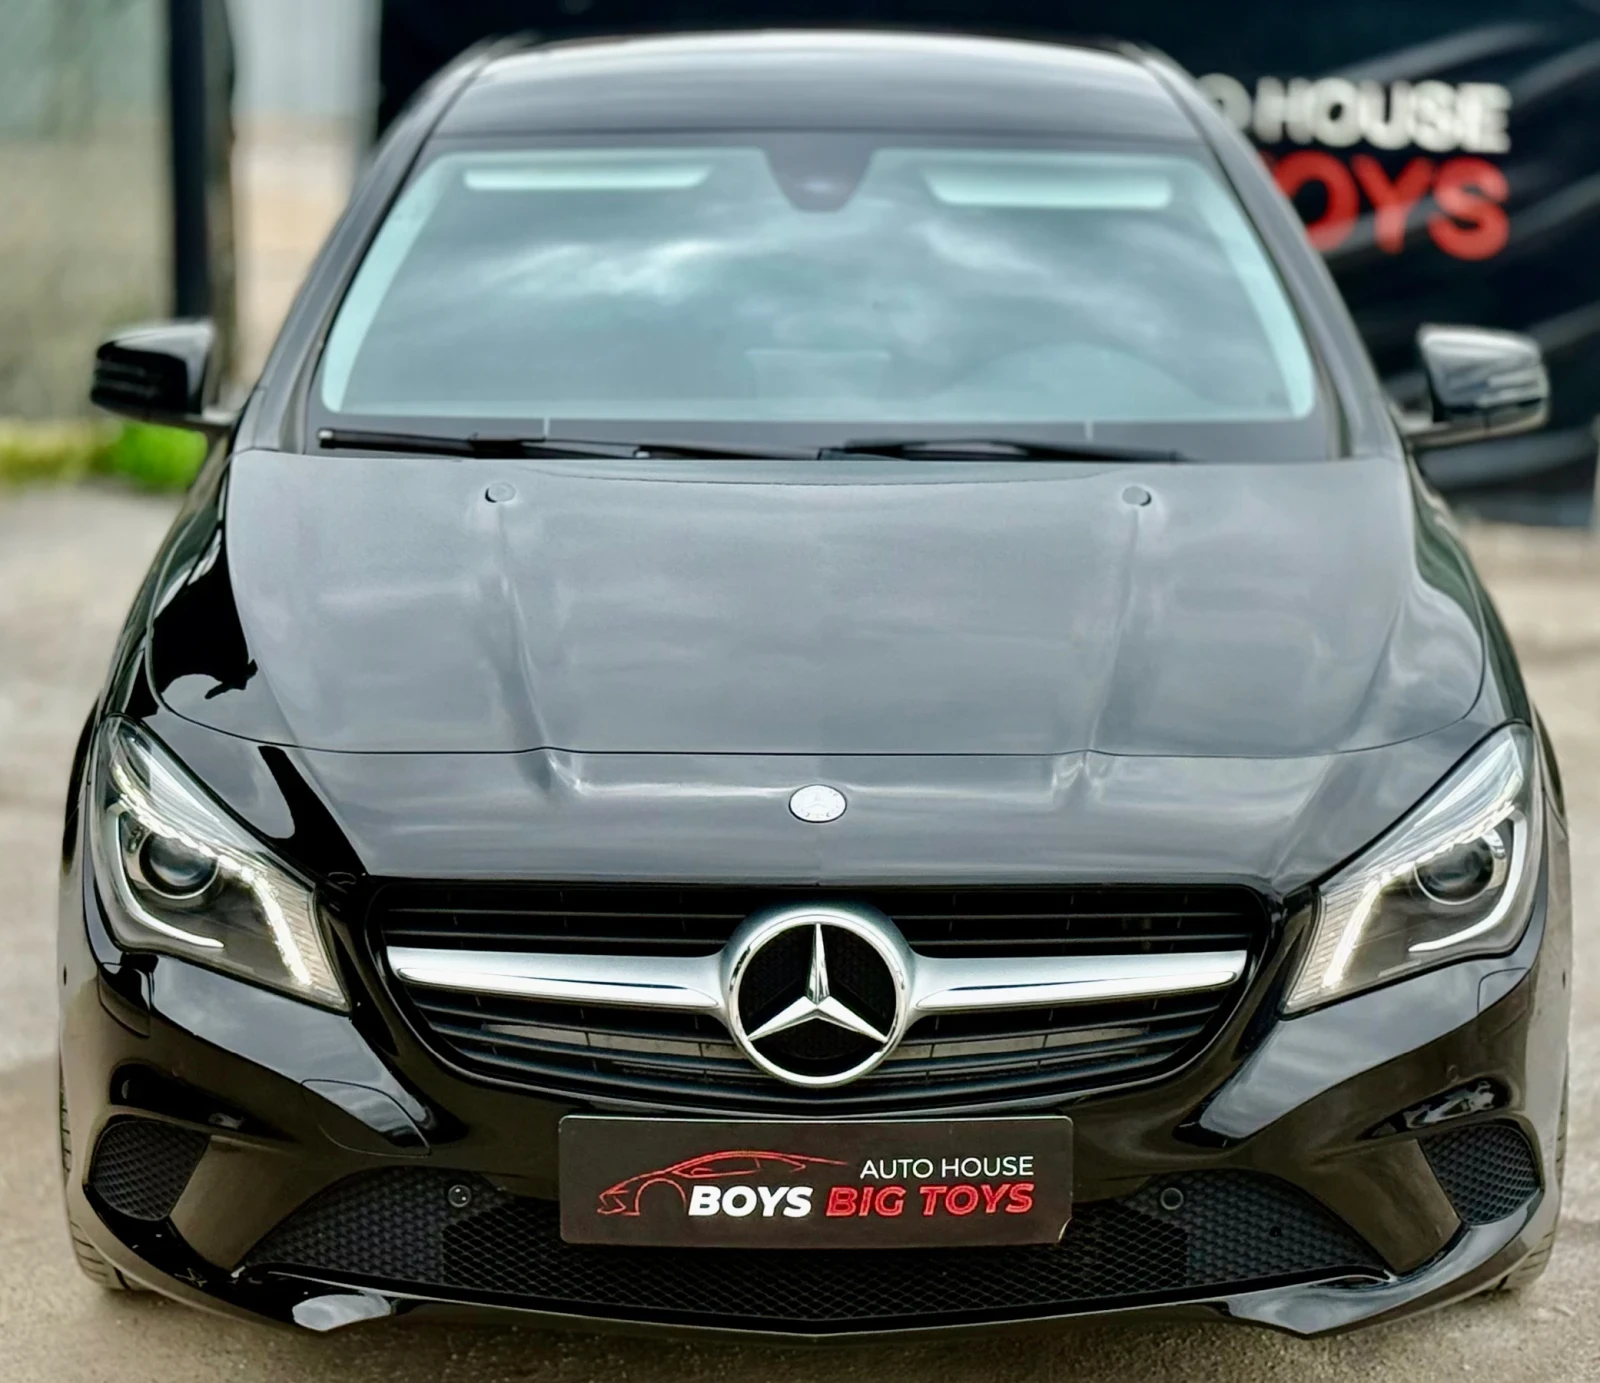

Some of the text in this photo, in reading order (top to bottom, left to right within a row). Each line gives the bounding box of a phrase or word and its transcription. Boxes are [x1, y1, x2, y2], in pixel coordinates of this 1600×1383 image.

[1253, 76, 1511, 154] HOUSE
[1264, 150, 1510, 260] OYS
[859, 1155, 1034, 1180] AUTO HOUSE
[687, 1182, 1035, 1218] BOYS BIG TOYS
